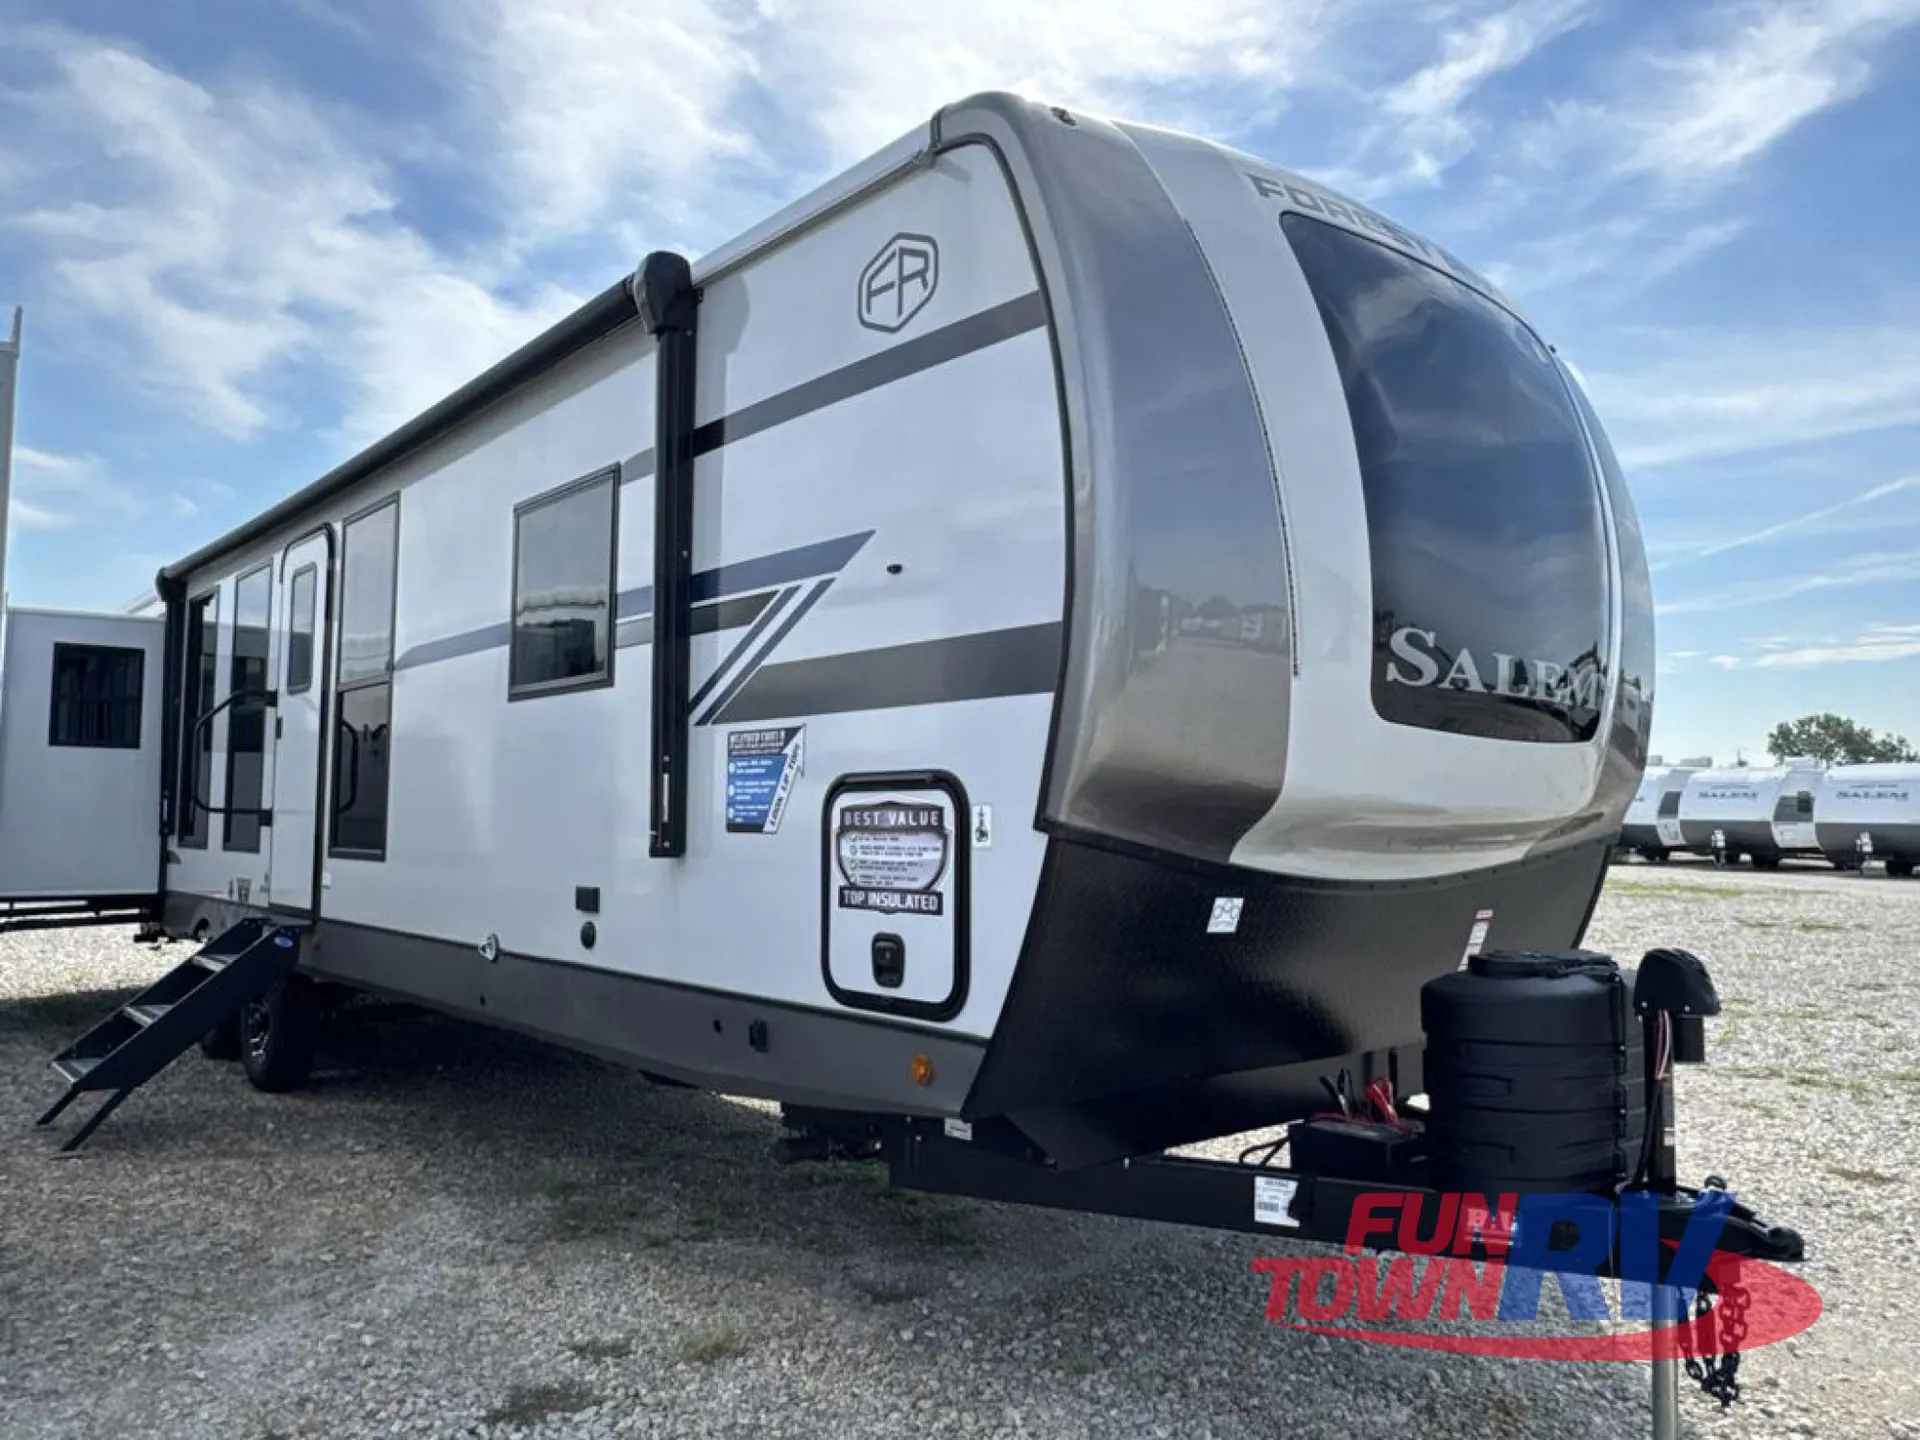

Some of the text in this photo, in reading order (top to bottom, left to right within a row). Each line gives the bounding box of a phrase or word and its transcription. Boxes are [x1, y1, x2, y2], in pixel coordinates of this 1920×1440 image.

[843, 811, 939, 826] BEST VALUE
[843, 890, 939, 912] TOP INSULATED
